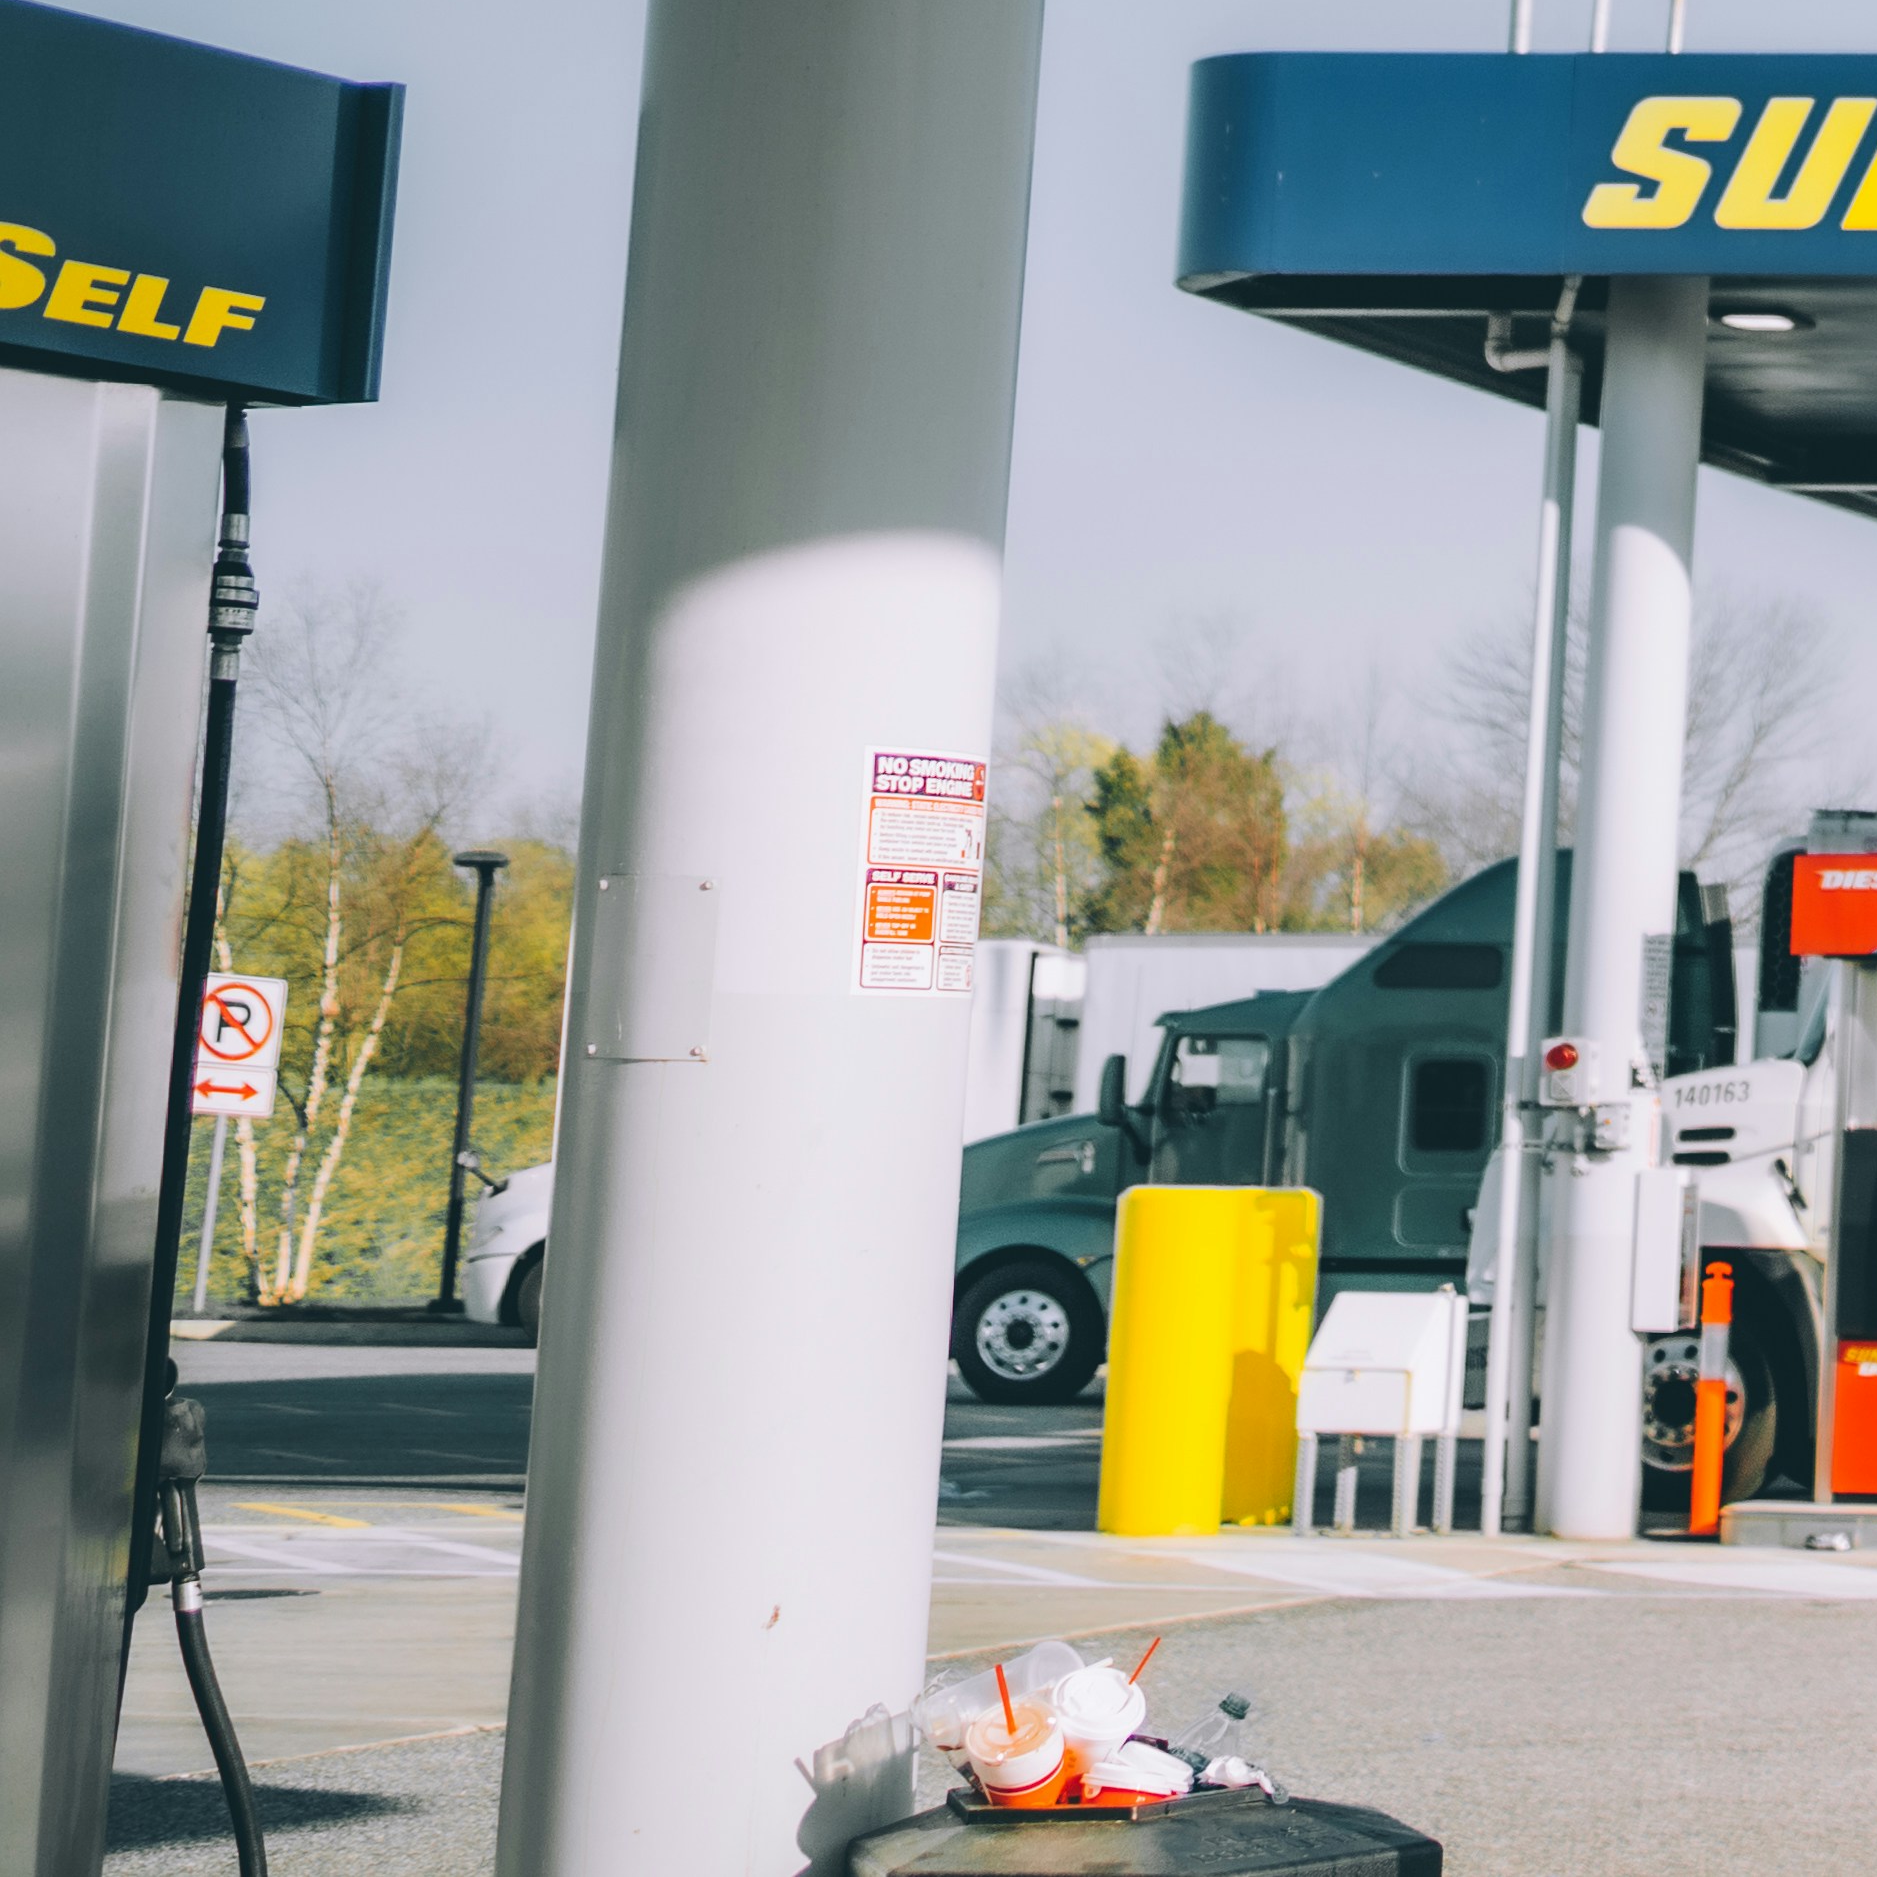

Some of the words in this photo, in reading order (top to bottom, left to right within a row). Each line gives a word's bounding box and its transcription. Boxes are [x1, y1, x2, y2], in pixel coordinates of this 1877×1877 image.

[0, 221, 267, 348] SELF
[877, 755, 908, 775] NO
[908, 758, 975, 782] SMOKING
[874, 774, 925, 793] STOP
[1674, 1081, 1751, 1109] 140163
